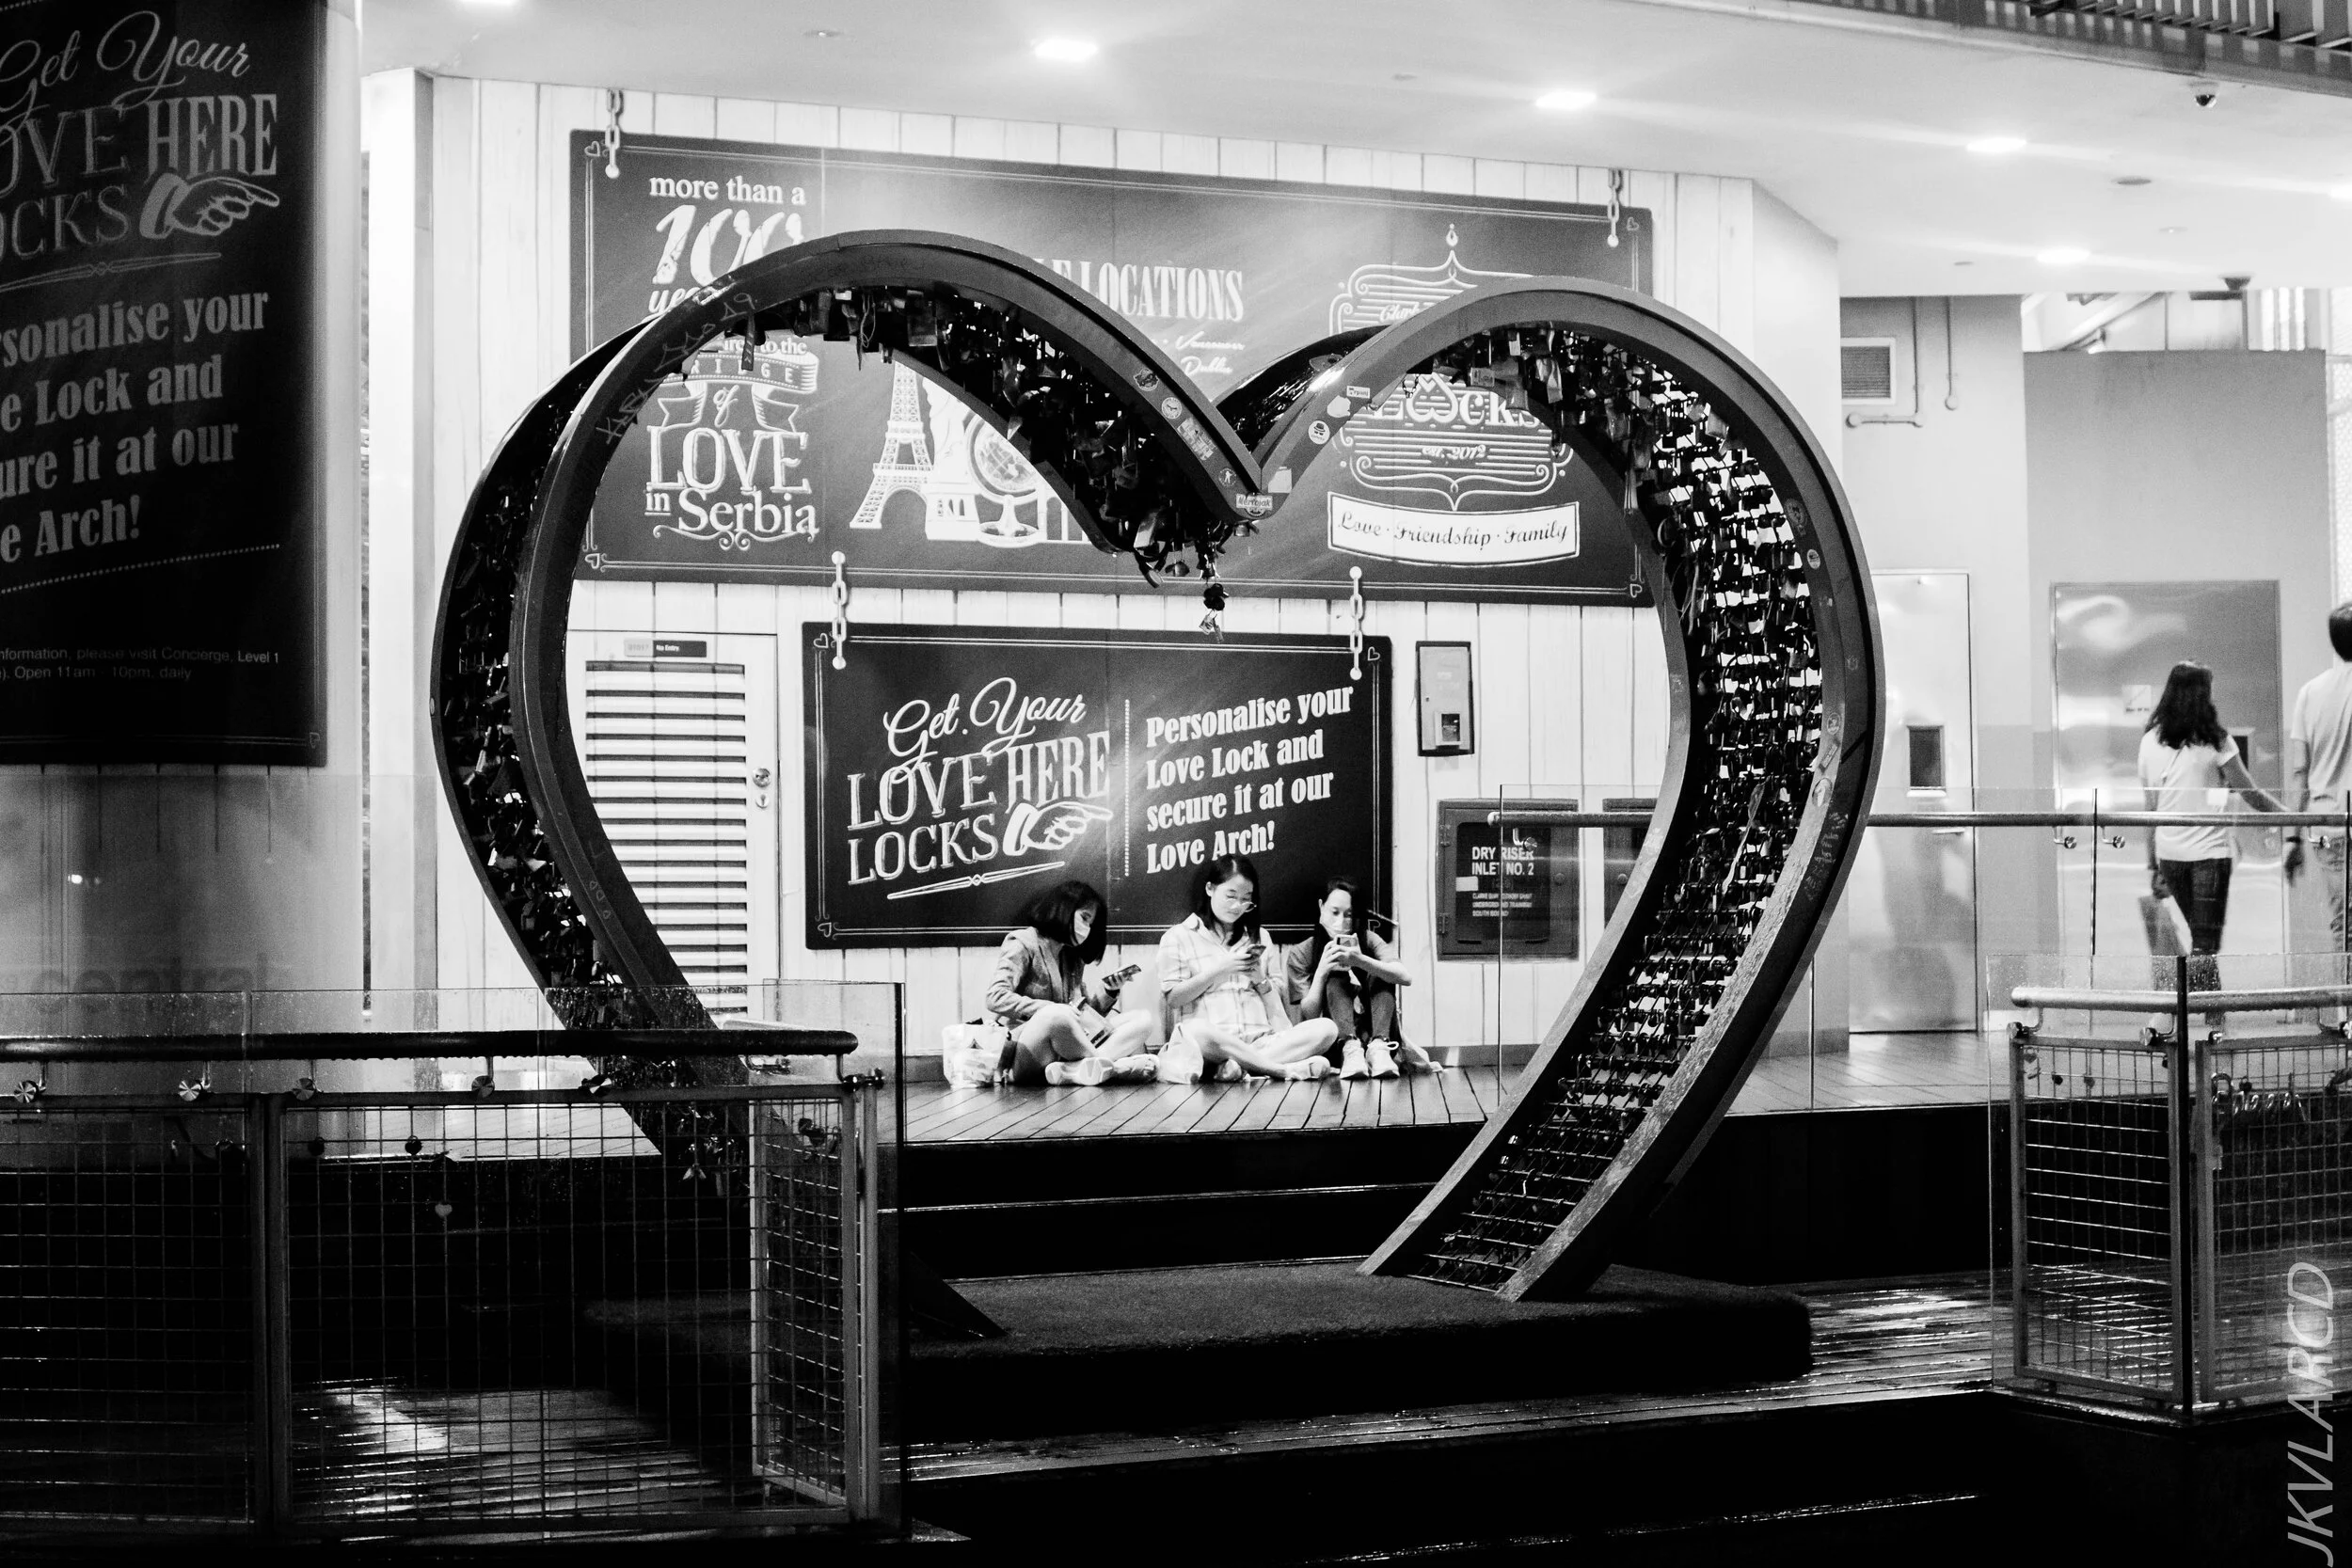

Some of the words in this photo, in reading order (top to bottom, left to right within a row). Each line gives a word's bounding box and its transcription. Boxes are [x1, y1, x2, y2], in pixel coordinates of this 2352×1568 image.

[97, 10, 250, 110] Your
[141, 94, 278, 184] HERE
[649, 176, 719, 199] more
[726, 175, 783, 204] than
[791, 186, 806, 205] a
[0, 184, 130, 260] CKS
[0, 302, 169, 367] sonalise
[183, 292, 269, 342] your
[781, 338, 806, 354] the
[34, 368, 132, 425] Lock
[147, 355, 223, 405] and
[712, 385, 739, 427] of
[72, 436, 101, 483] it
[116, 426, 156, 475] at
[172, 423, 238, 467] our
[646, 425, 812, 495] LOVE
[1448, 444, 1486, 460] 2012
[34, 495, 140, 557] Arch!
[645, 485, 671, 514] in
[678, 488, 818, 534] Serbia
[1338, 511, 1382, 536] Love
[1393, 520, 1492, 551] Friendship
[1503, 519, 1569, 545] Family
[14, 666, 51, 679] Open
[159, 666, 192, 681] daily
[76, 647, 124, 661] please
[130, 647, 156, 660] visit
[161, 647, 233, 662] Concierge,
[237, 650, 270, 663] Level
[274, 652, 279, 663] 1
[882, 693, 960, 784] Get
[969, 677, 1086, 757] Your
[1147, 697, 1291, 748] Personalise
[1297, 686, 1354, 724] your
[847, 752, 996, 831] LOVE
[1005, 731, 1110, 815] HERE
[1147, 755, 1205, 790] Love
[1212, 740, 1270, 778] Lock
[1277, 729, 1324, 766] and
[1147, 792, 1227, 832] secure
[1234, 784, 1252, 816] it
[1259, 777, 1284, 810] at
[1291, 772, 1334, 803] our
[848, 814, 998, 885] LOCKS
[1147, 839, 1205, 874] Love
[1212, 820, 1275, 861] Arch!
[1472, 846, 1497, 860] DRY
[1502, 847, 1534, 861] RISER
[1505, 862, 1525, 876] NO.
[1527, 862, 1534, 876] 2
